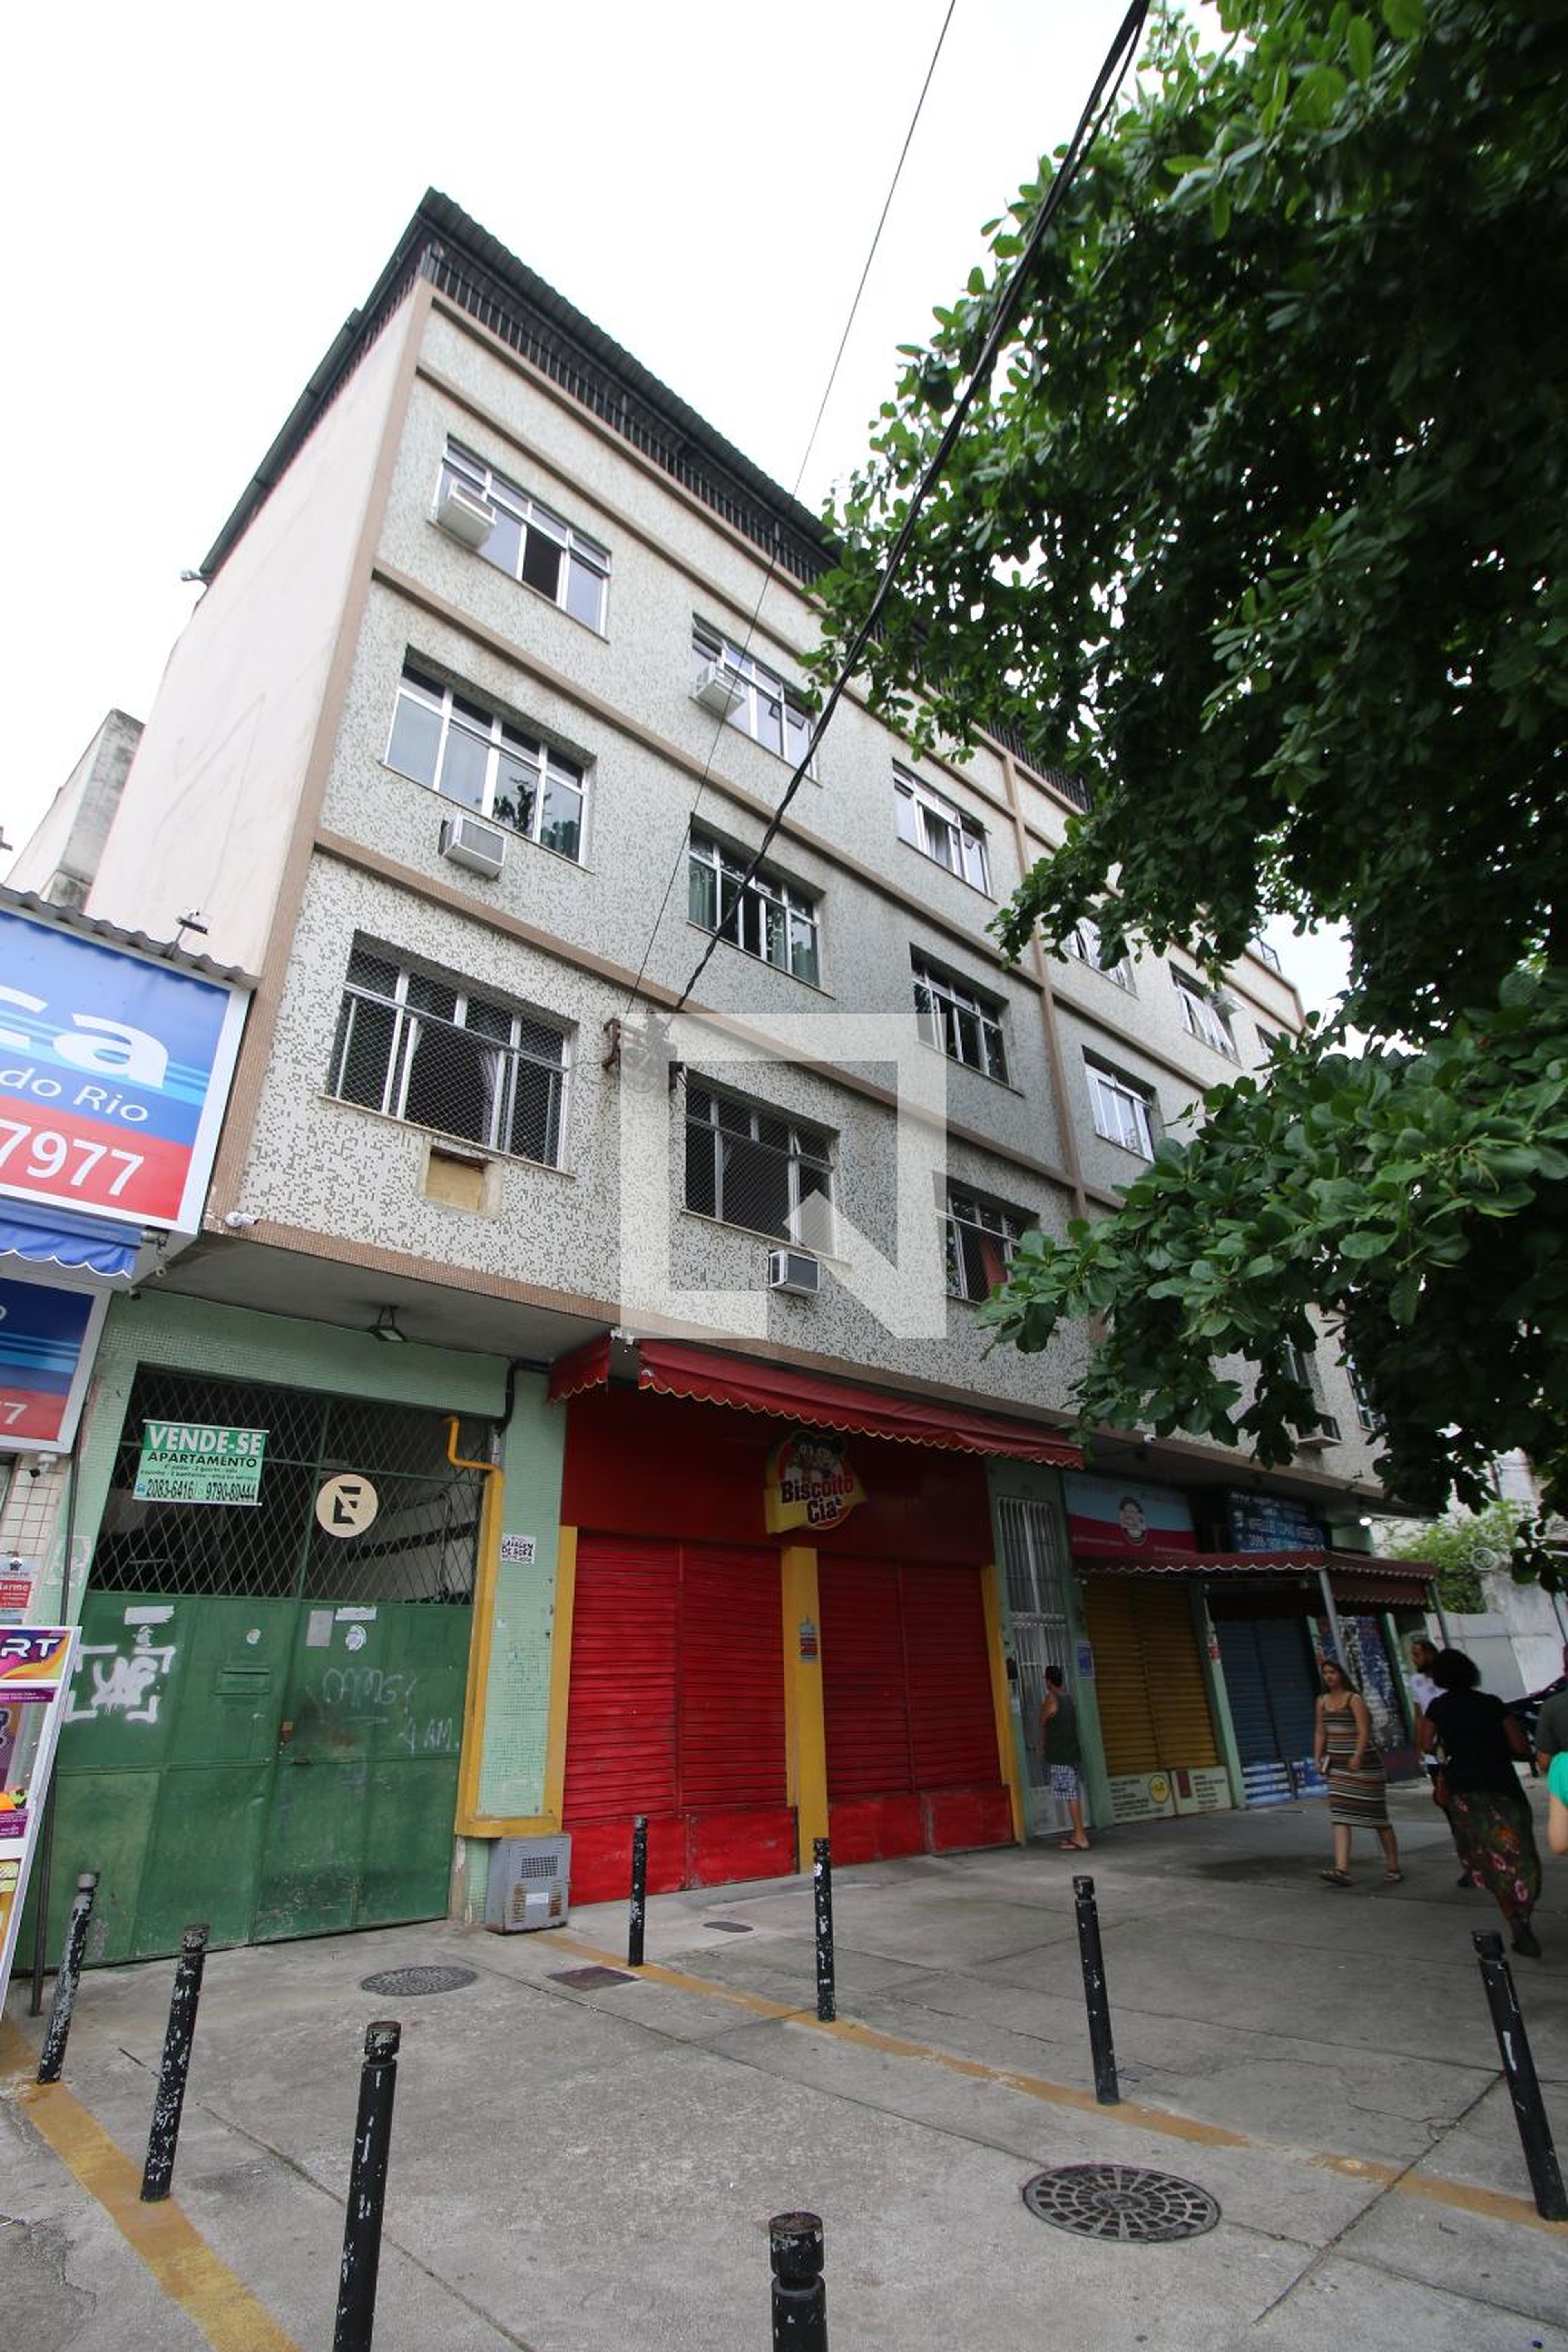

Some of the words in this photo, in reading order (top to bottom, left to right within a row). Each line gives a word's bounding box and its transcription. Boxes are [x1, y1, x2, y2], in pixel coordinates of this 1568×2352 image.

[0, 1067, 62, 1097] do
[73, 1085, 148, 1122] Rio
[0, 1118, 145, 1196] 7977
[149, 1425, 262, 1456] VENDE-SE
[147, 1452, 257, 1468] APARTAMENTO
[1, 1638, 60, 1657] RT
